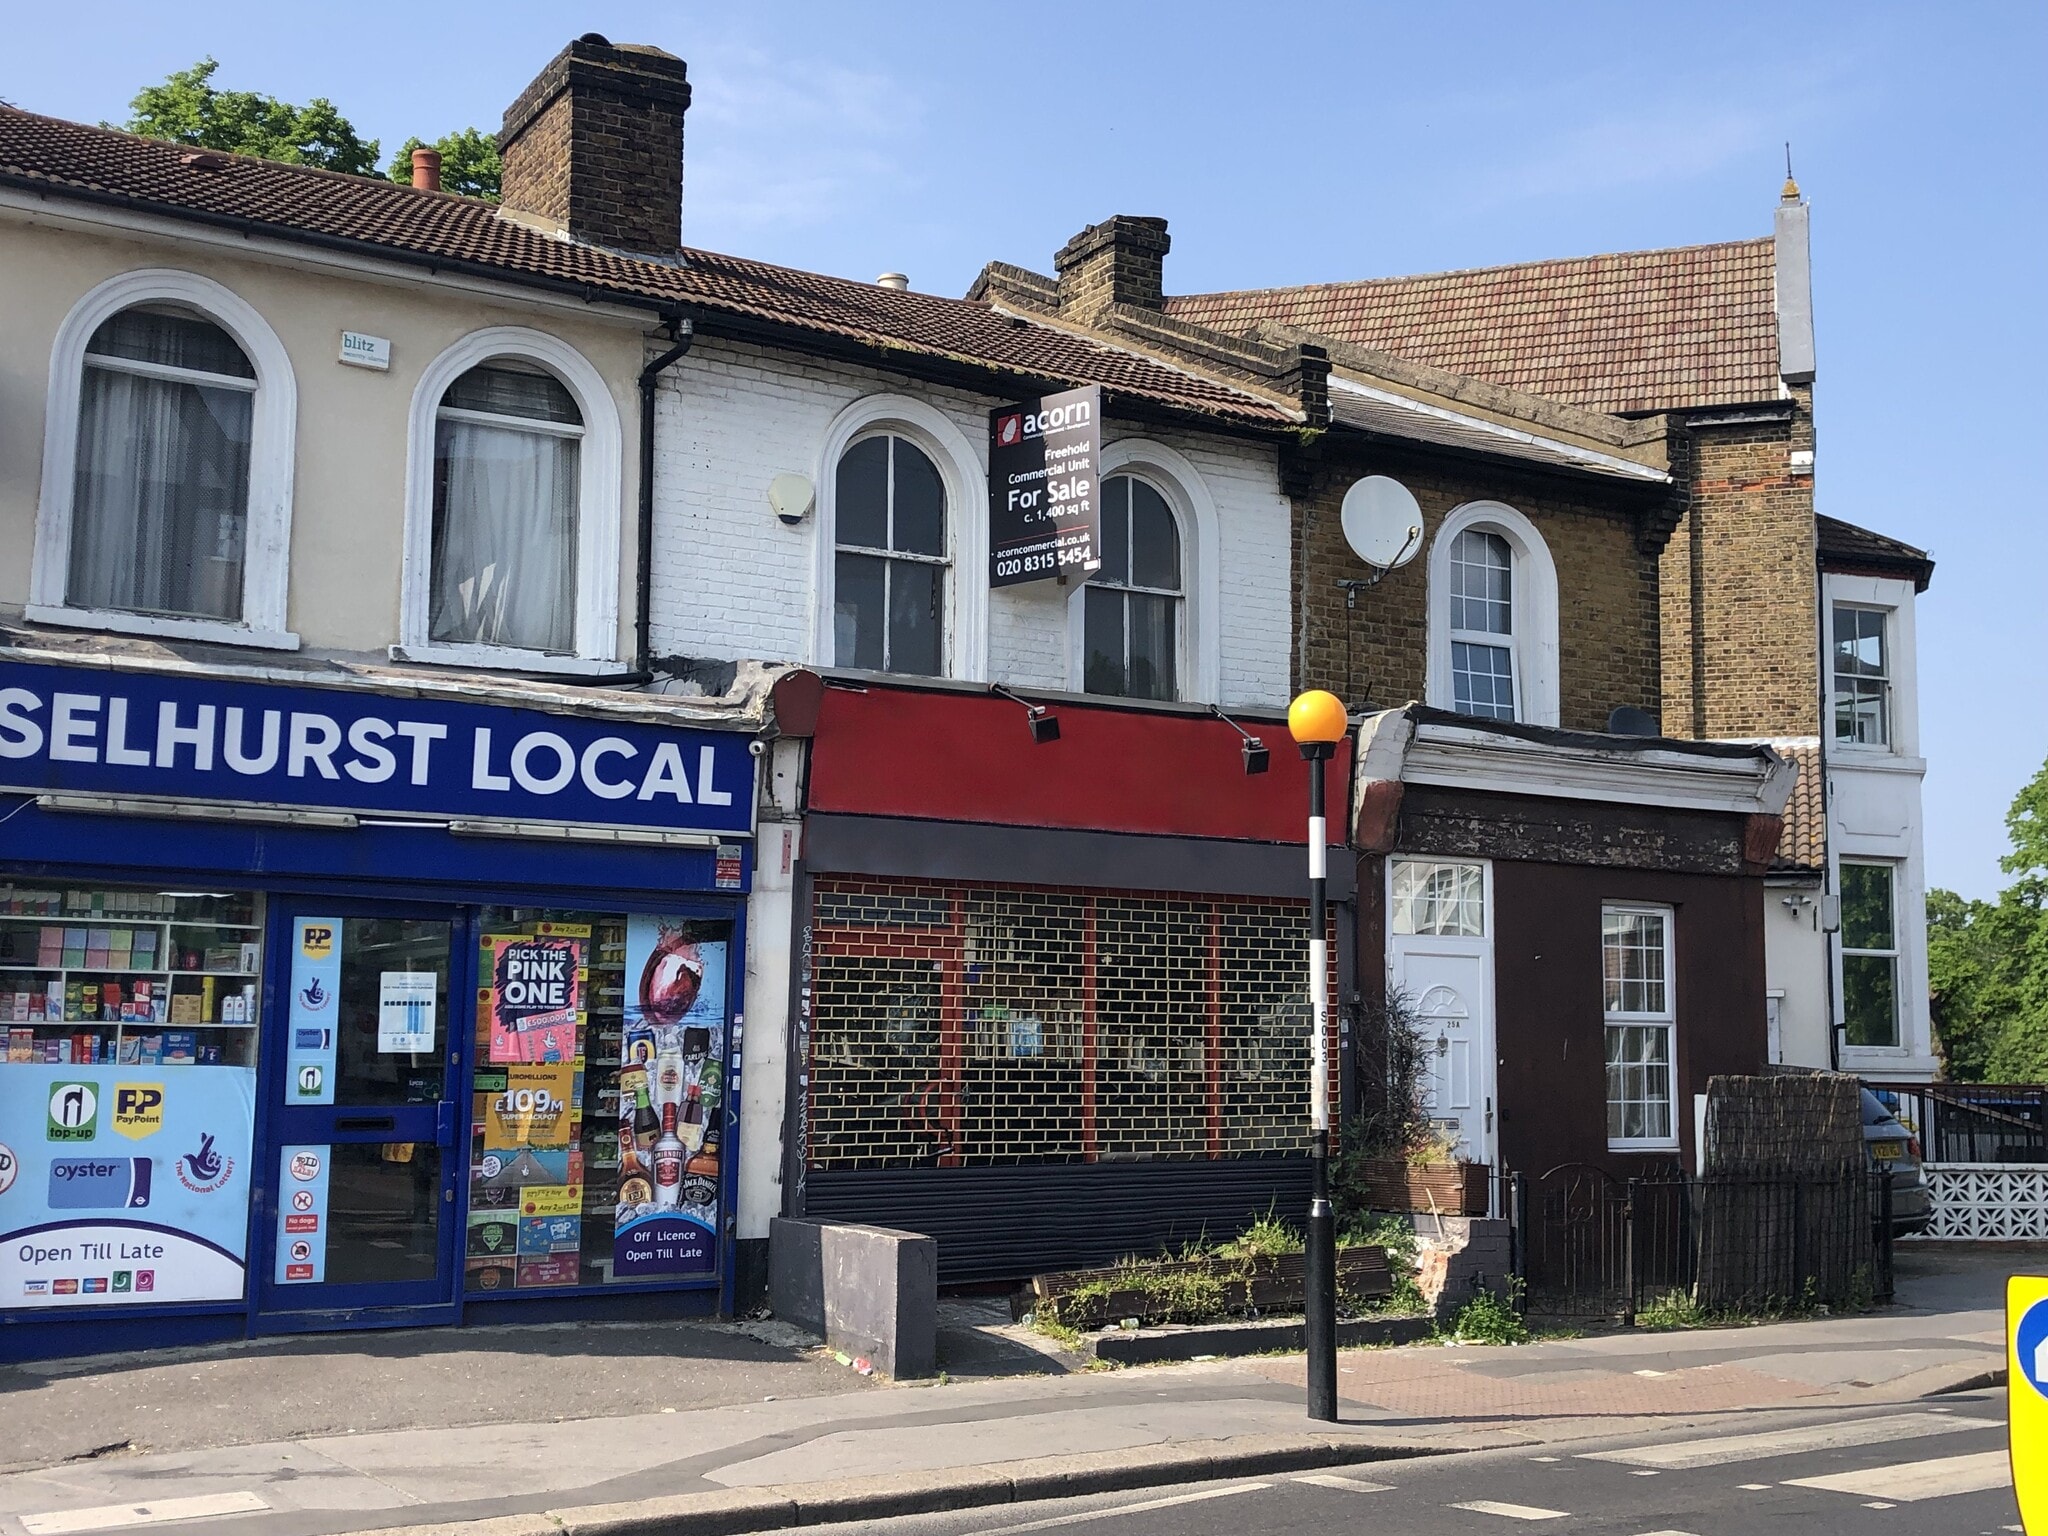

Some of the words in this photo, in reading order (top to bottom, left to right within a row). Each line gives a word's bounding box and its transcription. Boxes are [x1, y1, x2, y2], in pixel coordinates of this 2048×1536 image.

[344, 334, 375, 352] blitz
[1023, 400, 1090, 433] acorn
[1044, 441, 1090, 461] Freehold
[1008, 462, 1066, 485] Commercial
[1068, 457, 1090, 473] Unit
[1008, 488, 1041, 511] For
[1047, 476, 1090, 504] Sale
[1024, 512, 1033, 523] c.
[1037, 505, 1065, 522] 1,400
[1066, 505, 1079, 516] sq
[1080, 500, 1090, 512] ft
[997, 532, 1090, 558] acorncommercial.co.uk
[997, 558, 1021, 577] 020
[1024, 553, 1054, 572] 8315
[1058, 545, 1091, 567] 5454
[0, 687, 447, 784] SELHURST
[472, 727, 732, 806] LOCAL
[718, 860, 740, 868] Alarm
[305, 928, 332, 944] PP
[508, 949, 539, 960] PICK
[542, 950, 567, 961] THE
[507, 961, 565, 980] PINK
[504, 981, 565, 1004] ONE
[527, 1013, 566, 1026] £500,000
[684, 1051, 708, 1061] CARLING
[118, 1090, 162, 1114] PP
[495, 1088, 563, 1112] £109M
[116, 1115, 159, 1124] PayPoint
[50, 1127, 93, 1139] top-up
[654, 1150, 683, 1158] SMIRNOFF
[54, 1162, 116, 1181] oyster
[175, 1160, 183, 1176] The
[180, 1176, 214, 1193] National
[215, 1160, 235, 1188] Lottery
[683, 1178, 697, 1189] JACK
[299, 1217, 315, 1225] dogs
[550, 1222, 571, 1236] POP
[634, 1231, 651, 1242] Off
[657, 1230, 696, 1241] Licence
[19, 1245, 72, 1265] Open
[80, 1243, 112, 1260] Till
[121, 1243, 164, 1259] Late
[626, 1250, 652, 1262] Open
[656, 1249, 673, 1259] Till
[680, 1247, 702, 1258] Late
